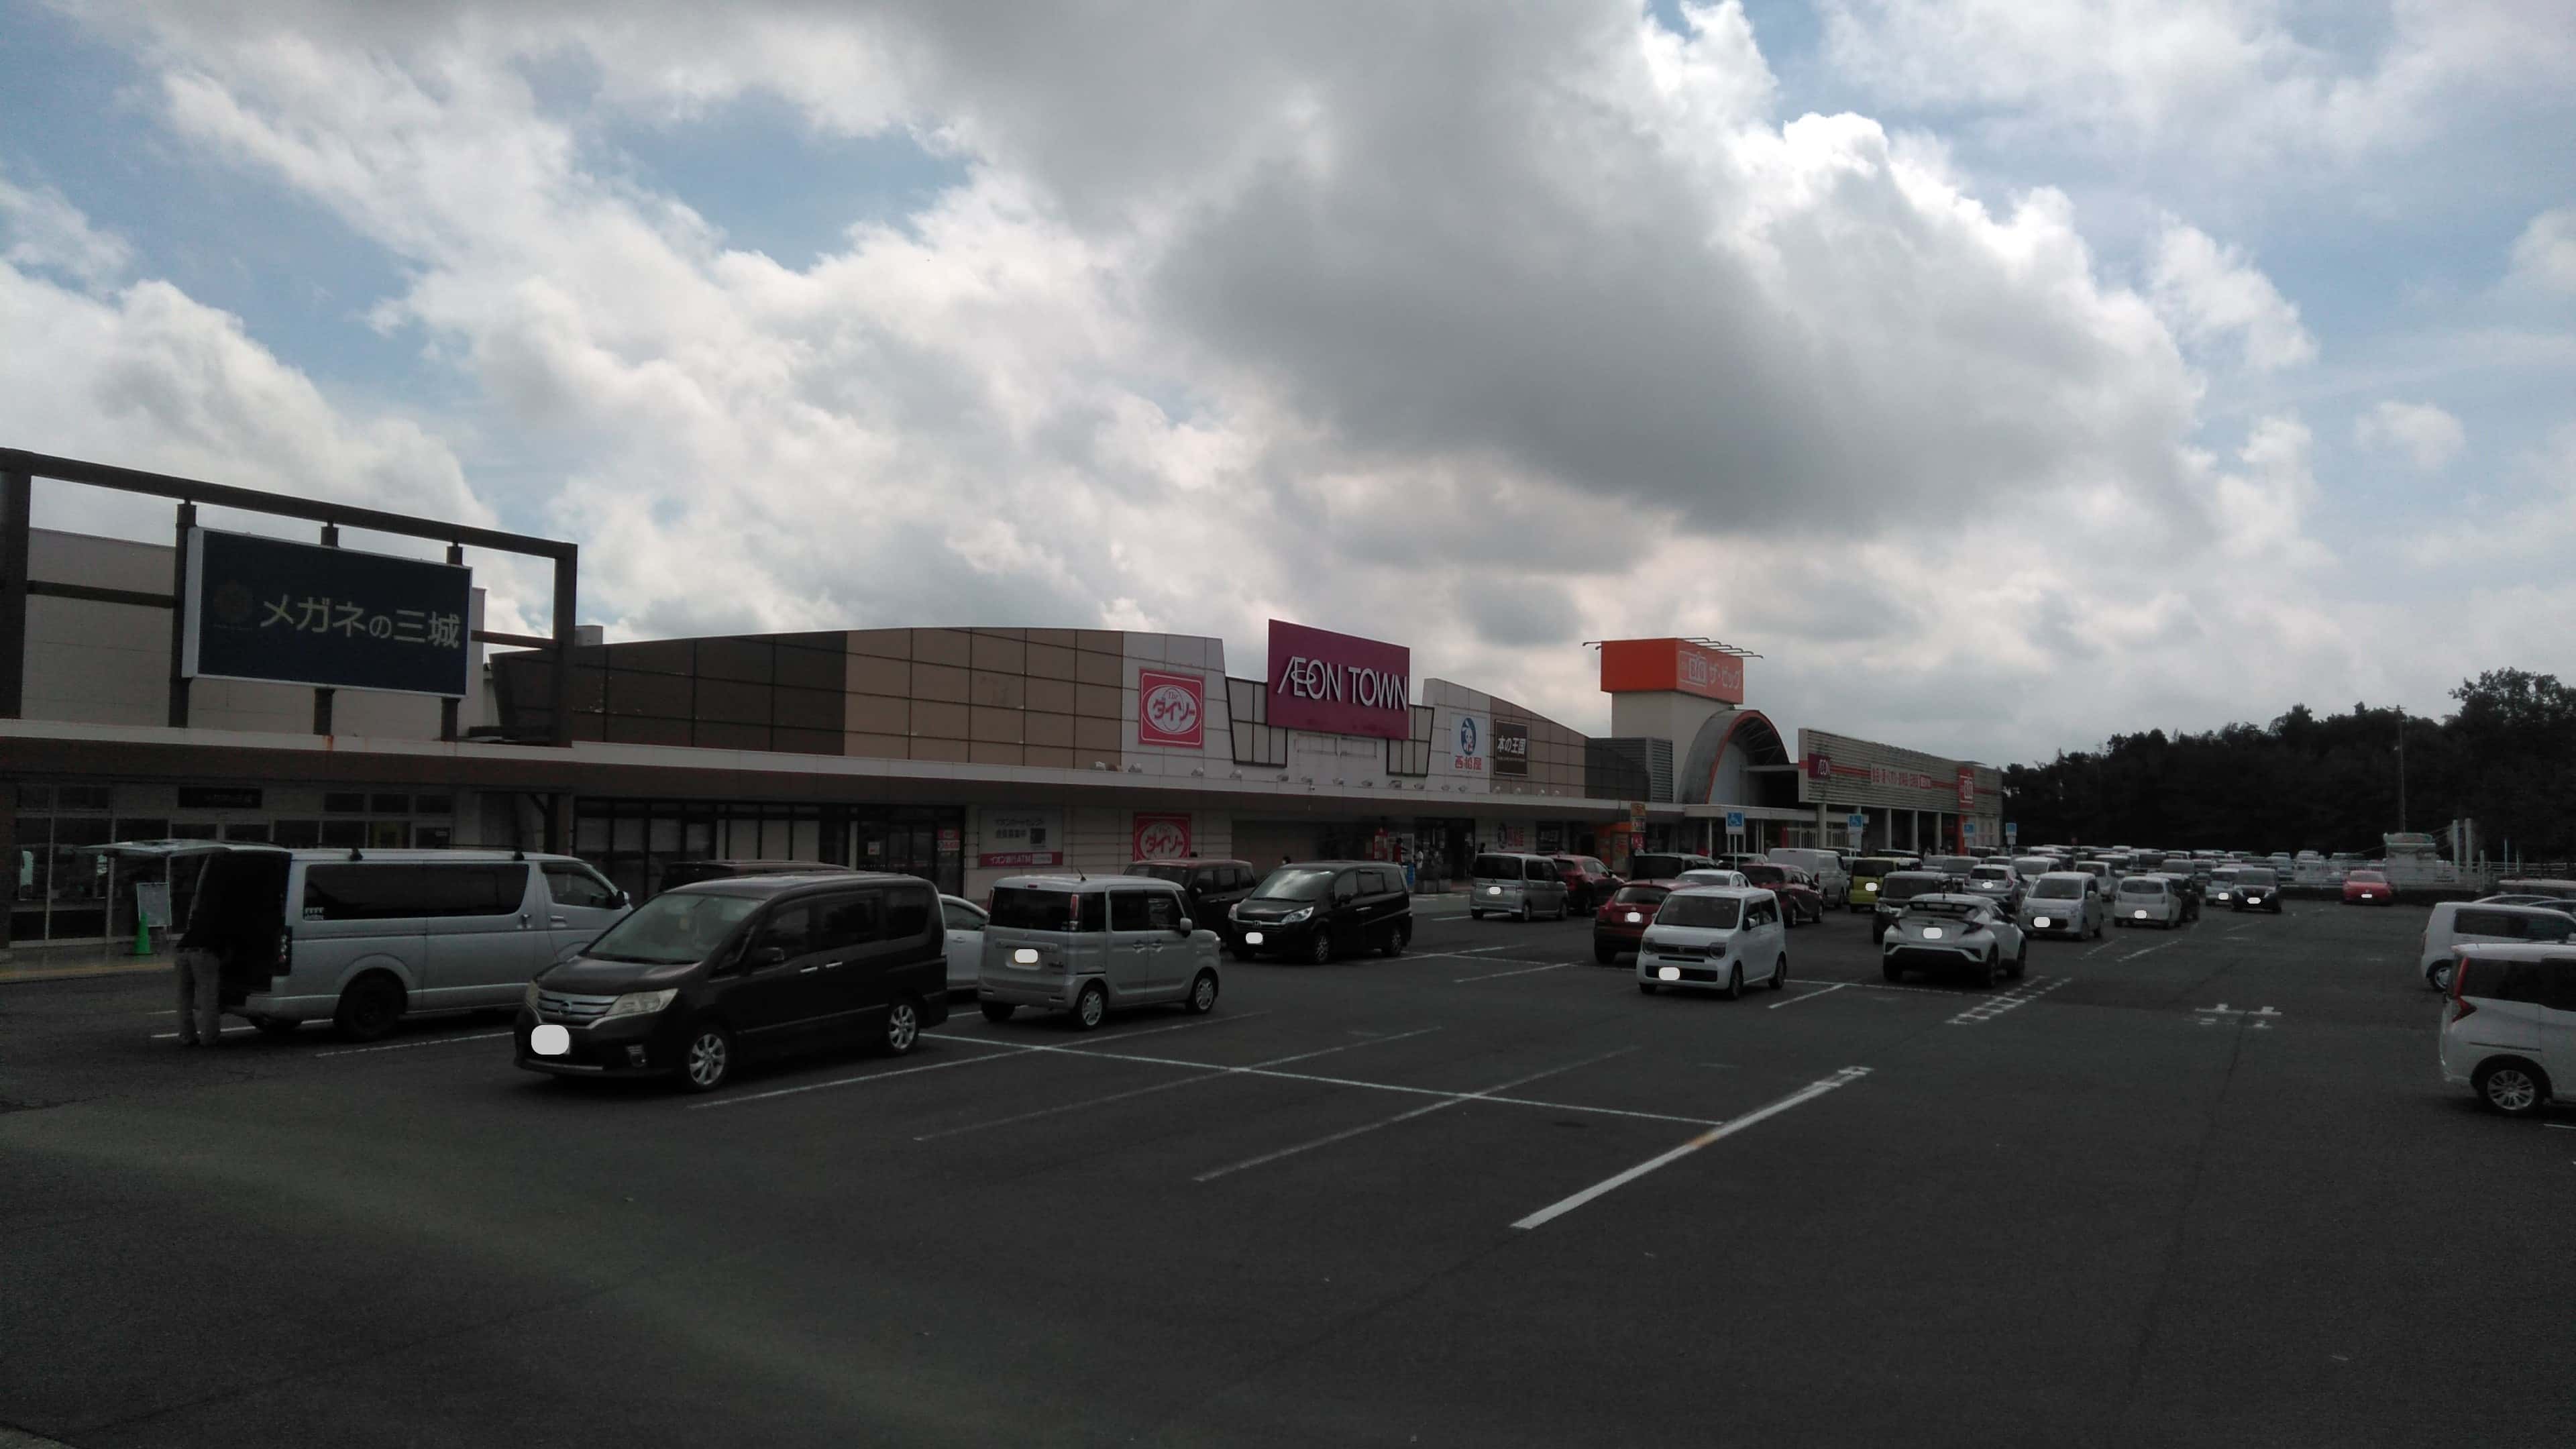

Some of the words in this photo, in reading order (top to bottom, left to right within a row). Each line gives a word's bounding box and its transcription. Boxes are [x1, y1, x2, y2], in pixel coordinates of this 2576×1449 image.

[260, 593, 462, 649] メガネの三城
[1348, 667, 1407, 711] TOWN
[1153, 698, 1195, 721] ダイソー
[1497, 735, 1526, 755] 本の王国
[1454, 755, 1481, 770] 西松屋
